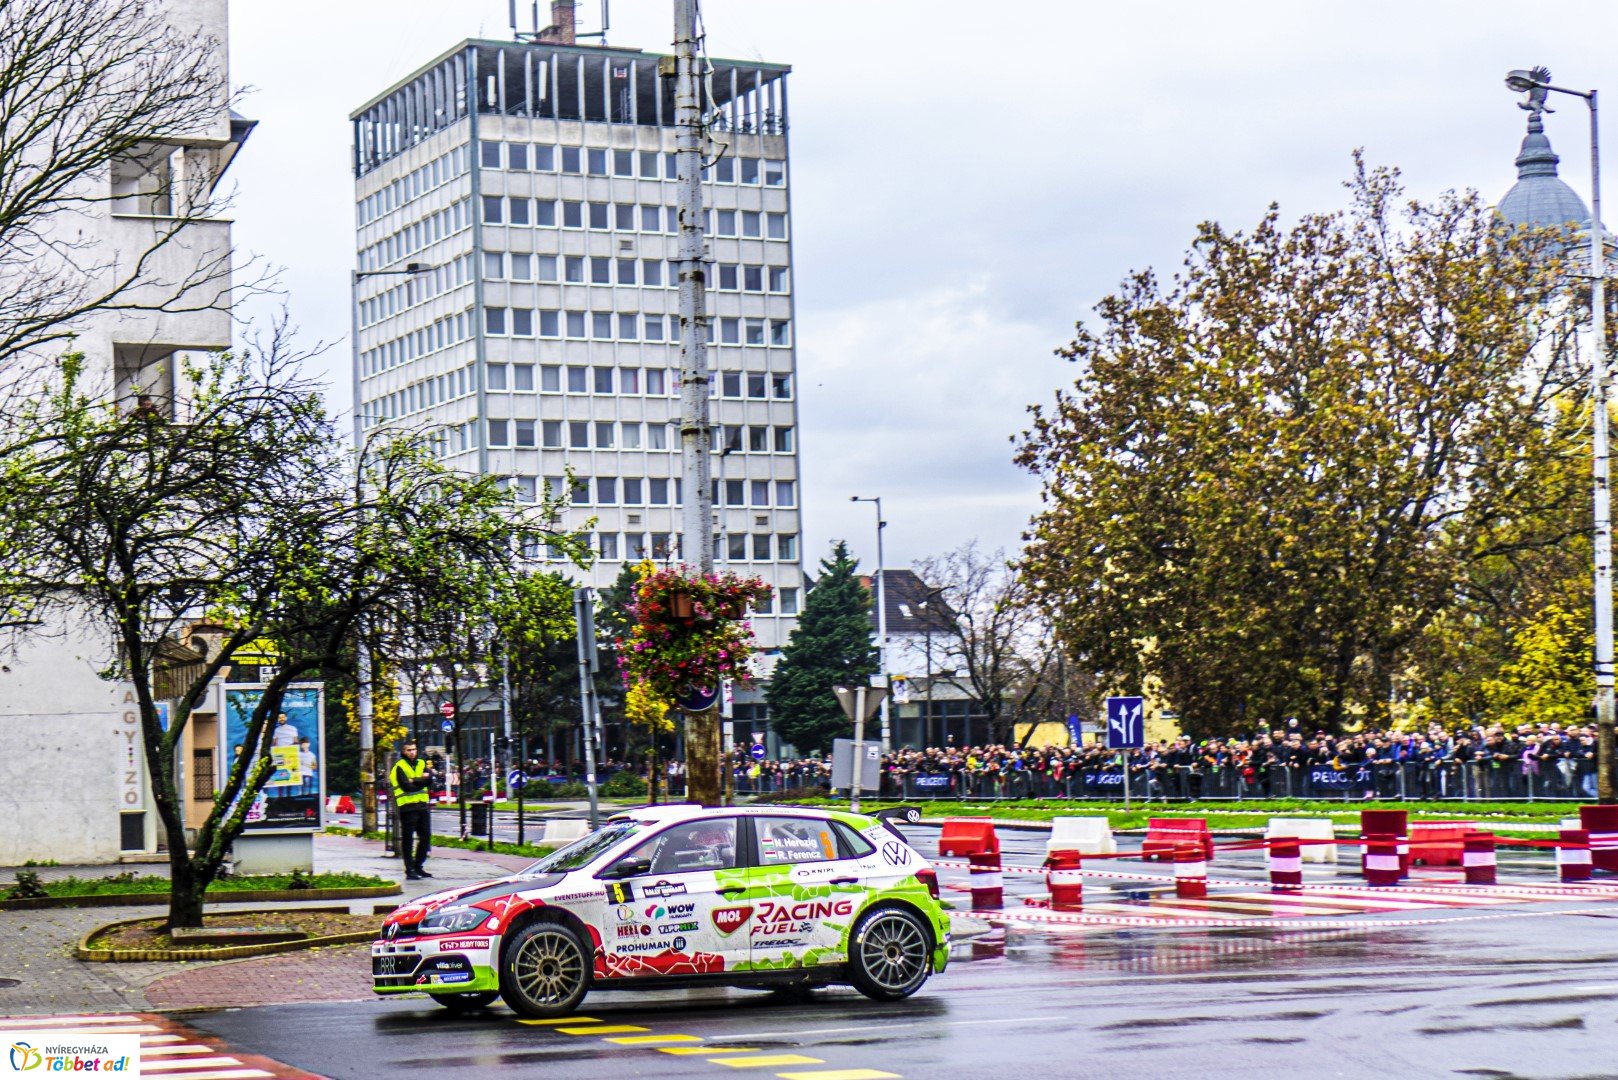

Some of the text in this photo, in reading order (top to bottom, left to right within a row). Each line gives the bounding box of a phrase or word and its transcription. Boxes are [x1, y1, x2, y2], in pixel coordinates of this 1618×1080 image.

[819, 831, 835, 860] 5
[778, 851, 821, 861] R. Ferencz
[554, 890, 605, 901] EVENTSTUFF.HU
[613, 883, 625, 904] 5
[668, 903, 695, 914] WOW
[757, 899, 853, 924] RACING
[717, 910, 741, 923] MOL
[617, 925, 640, 937] HELL
[750, 922, 798, 937] FUEL
[475, 940, 489, 948] TOOLS
[617, 941, 670, 953] PROHUMAN
[753, 938, 801, 947] TRELOG
